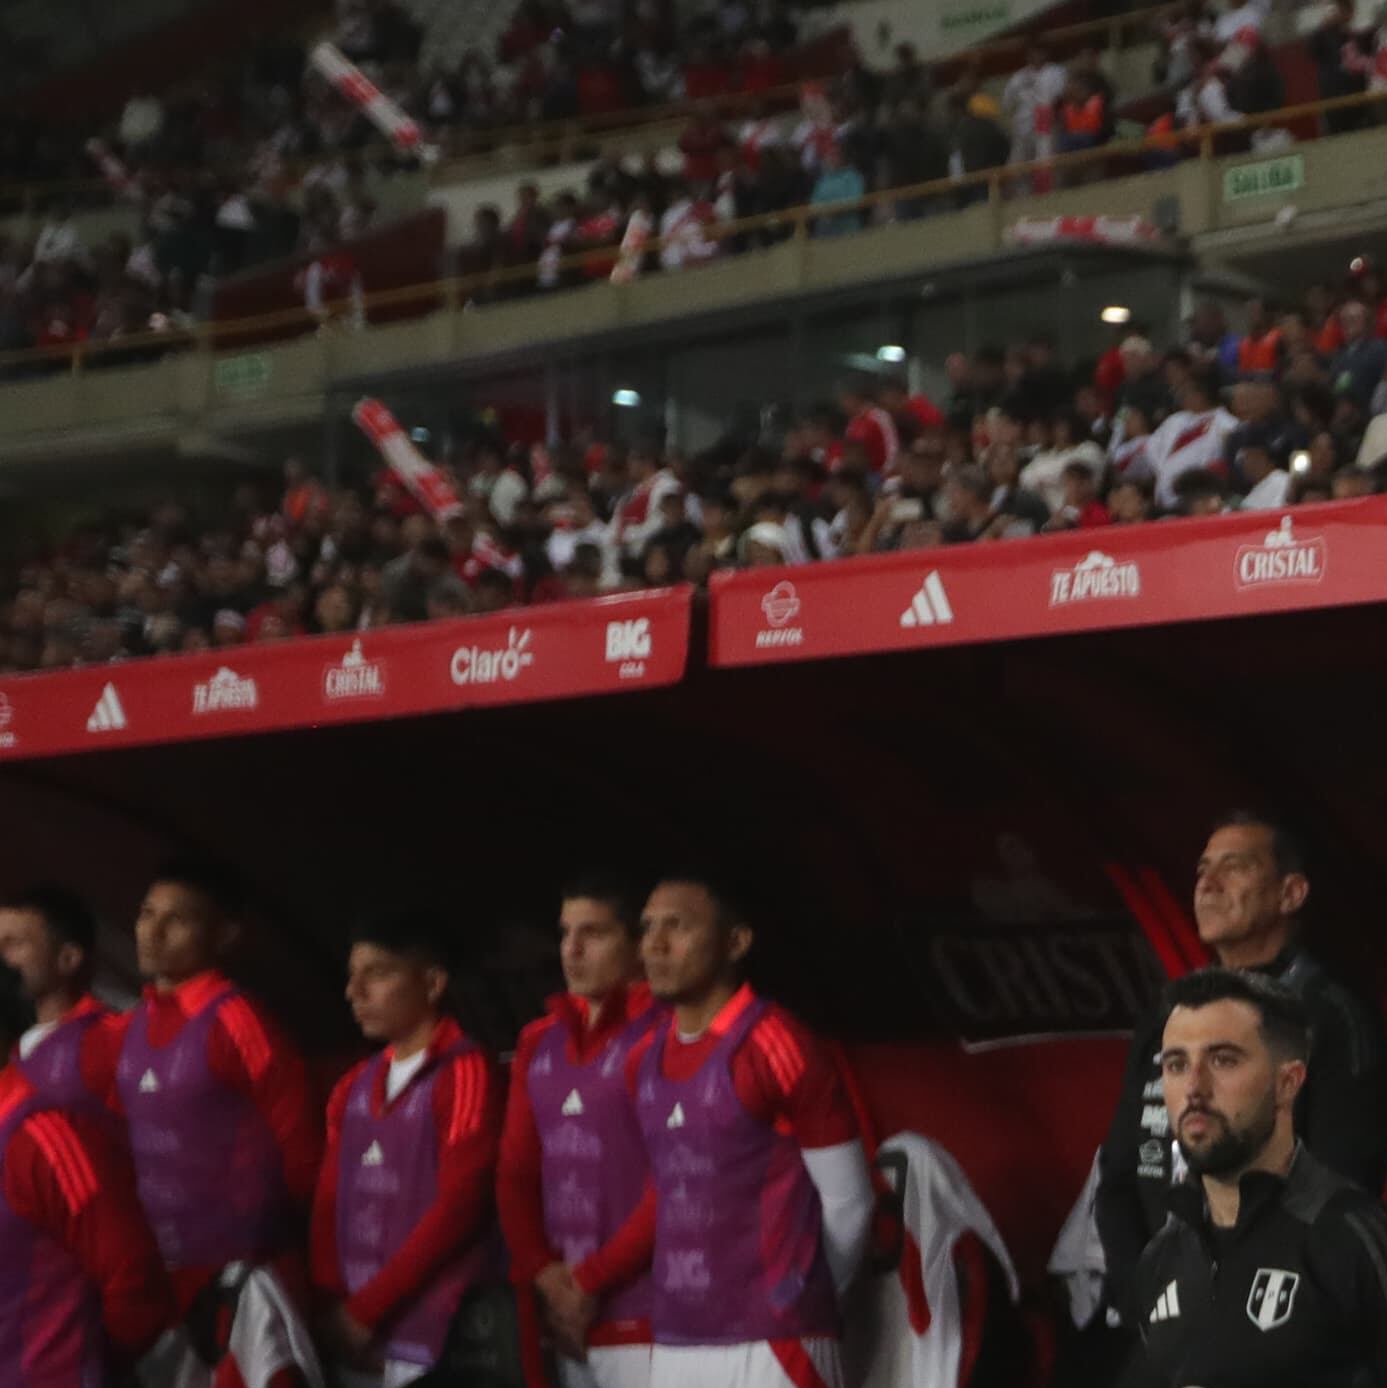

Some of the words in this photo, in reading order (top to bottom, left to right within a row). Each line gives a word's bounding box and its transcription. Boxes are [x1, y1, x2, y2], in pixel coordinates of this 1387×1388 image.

[1050, 571, 1071, 602] TE
[1072, 566, 1140, 598] APUESTO
[1239, 547, 1320, 583] CRISTAL
[605, 618, 651, 661] BIG
[451, 645, 522, 685] Claro
